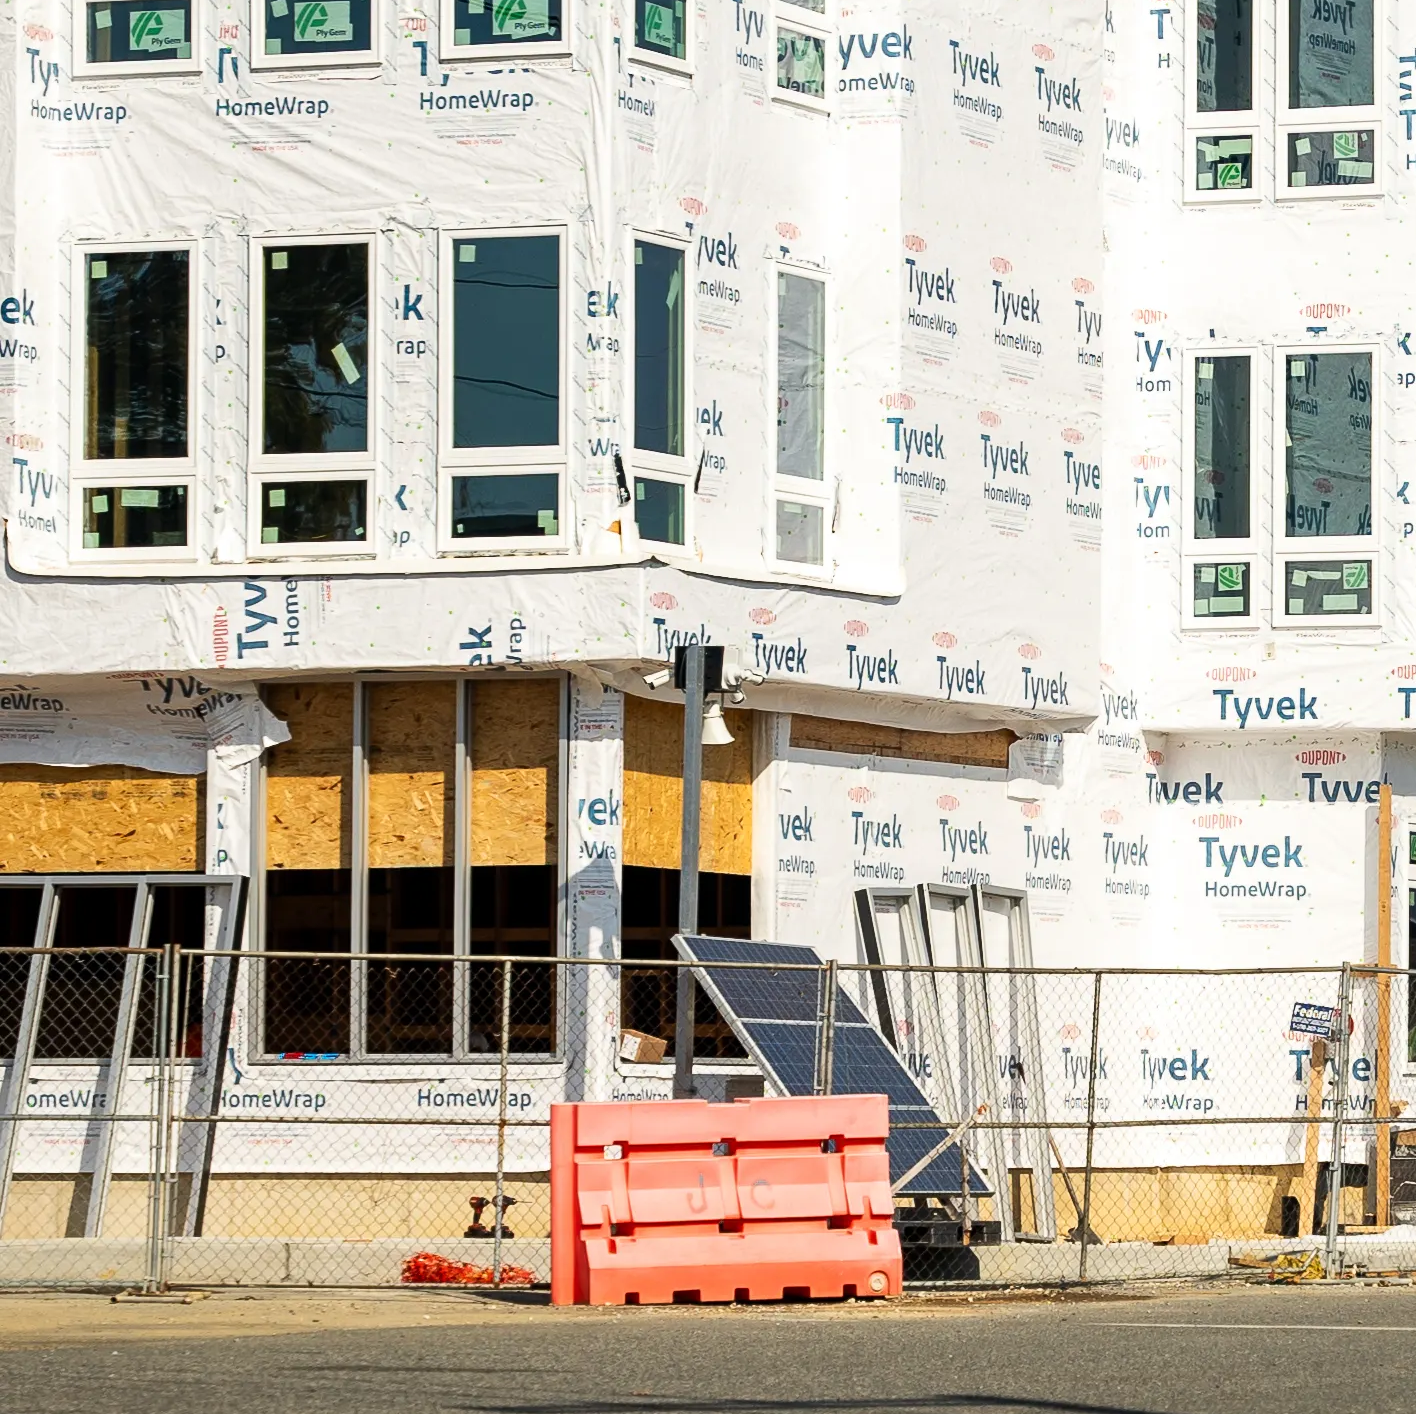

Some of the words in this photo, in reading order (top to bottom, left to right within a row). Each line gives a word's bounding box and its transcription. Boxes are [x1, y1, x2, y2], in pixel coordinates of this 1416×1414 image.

[152, 37, 163, 46] Ply
[316, 29, 328, 37] Ply
[515, 22, 526, 31] Ply
[736, 47, 763, 71] Home
[950, 40, 1000, 86] Tyvek
[420, 90, 533, 112] HomeWrap
[1035, 67, 1081, 112] Tyvek
[31, 99, 127, 124] HomeWrap
[216, 96, 330, 124] HomeWrap
[953, 89, 1002, 122] HomeWrap
[1038, 114, 1083, 146] HomeWrap
[905, 258, 956, 305] Tyvek
[992, 280, 1040, 325] Tyvek
[1306, 305, 1347, 319] DUPONT
[908, 308, 957, 338] HomeWrap
[994, 328, 1041, 357] HomeWrap
[886, 417, 944, 463] Tyvek
[980, 434, 1028, 479] Tyvek
[894, 466, 946, 499] HomeWrap
[984, 482, 1031, 511] HomeWrap
[213, 614, 228, 662] DUPONT
[752, 633, 808, 675] Tyvek
[846, 645, 899, 690] Tyvek
[937, 656, 985, 700] Tyvek
[1021, 667, 1068, 709] Tyvek
[1212, 668, 1251, 682] DUPONT
[1213, 688, 1318, 729] Tyvek
[1098, 730, 1141, 753] HomeWrap
[1301, 751, 1341, 765] DUPONT
[852, 811, 902, 855] Tyvek
[1199, 815, 1237, 829] DUPONT
[940, 819, 988, 862] Tyvek
[1024, 826, 1070, 867] Tyvek
[1103, 833, 1148, 873] Tyvek
[853, 859, 904, 881] HomeWrap
[1199, 836, 1303, 877] Tyvek
[942, 866, 990, 886] HomeWrap
[1025, 872, 1071, 891] HomeWrap
[1106, 878, 1149, 899] HomeWrap
[1205, 882, 1307, 900] HomeWrap
[1294, 1004, 1331, 1020] Federal
[1141, 1049, 1210, 1089] Tyvek
